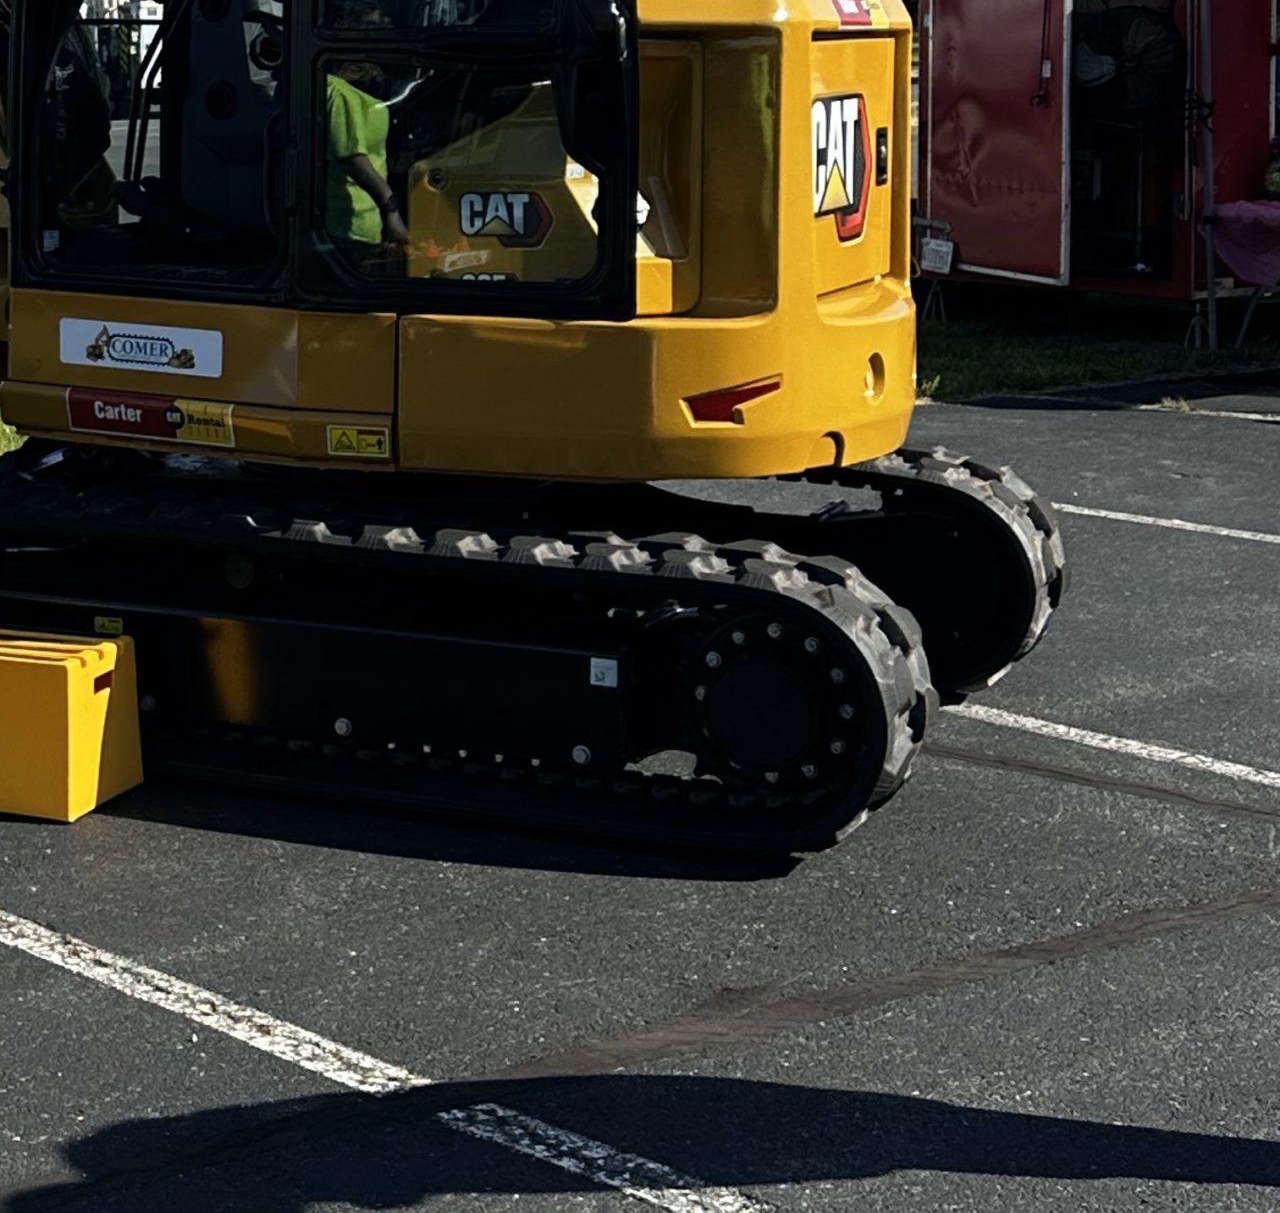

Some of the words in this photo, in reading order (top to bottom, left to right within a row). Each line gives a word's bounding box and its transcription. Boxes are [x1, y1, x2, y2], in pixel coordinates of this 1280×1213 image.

[811, 97, 859, 214] CAT
[460, 193, 530, 236] CAT
[112, 338, 169, 357] COMER
[94, 400, 142, 423] Carter
